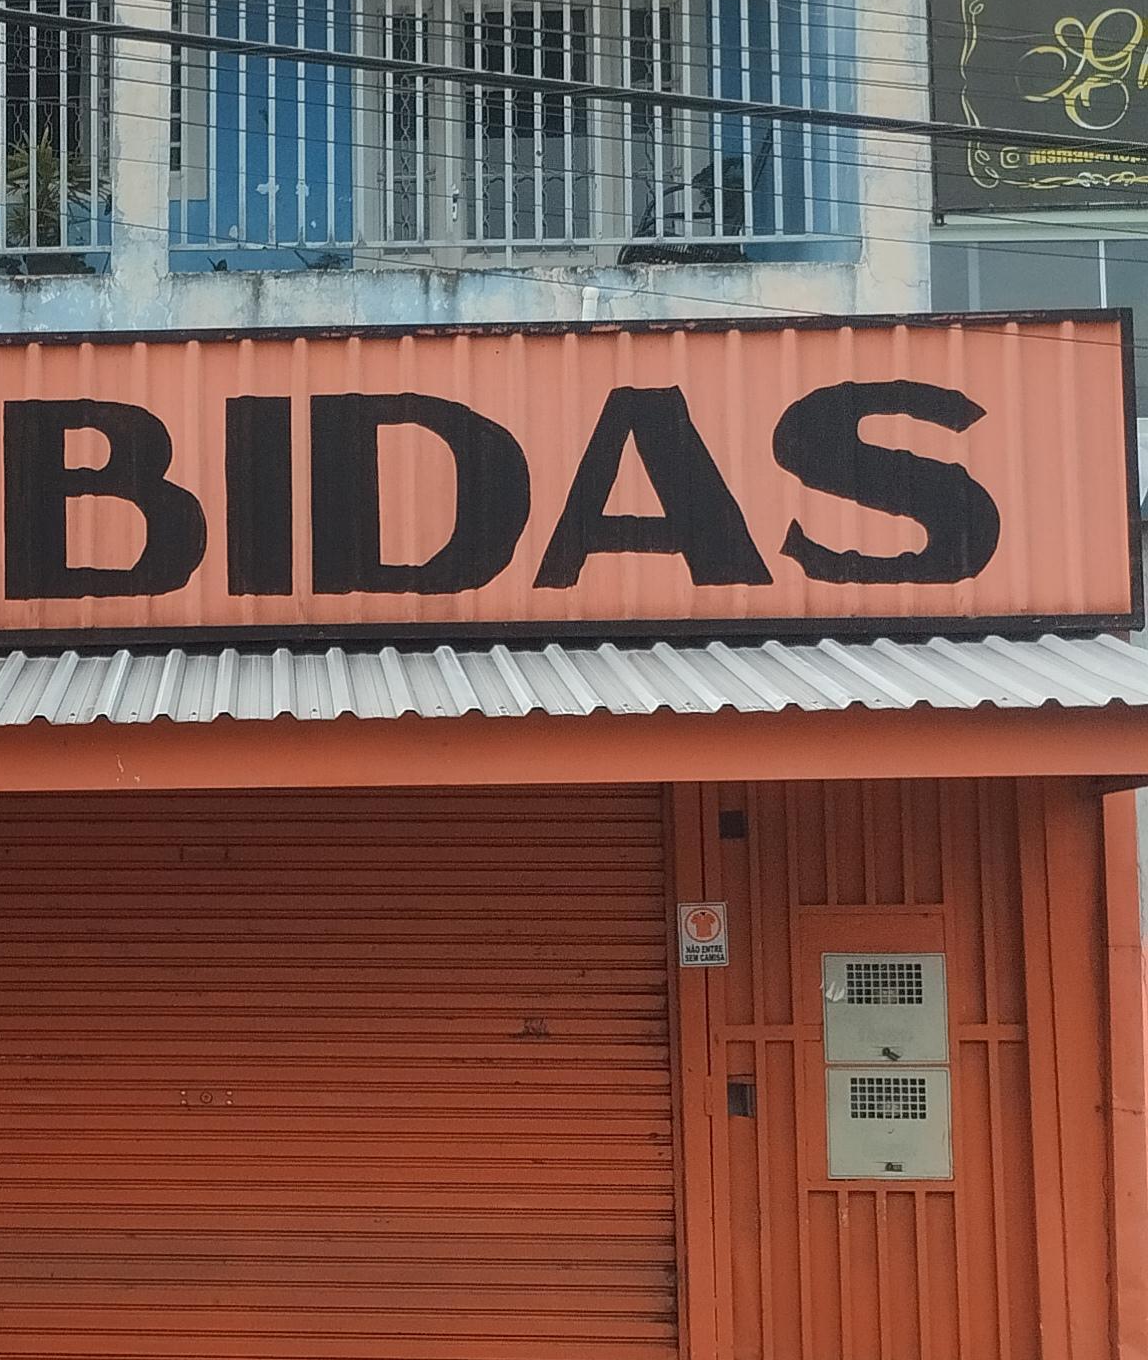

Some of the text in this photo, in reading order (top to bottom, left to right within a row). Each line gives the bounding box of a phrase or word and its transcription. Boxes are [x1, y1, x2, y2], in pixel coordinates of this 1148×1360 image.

[685, 943, 723, 954] NÃO ENTRE
[684, 953, 725, 962] SEM CAMISA
